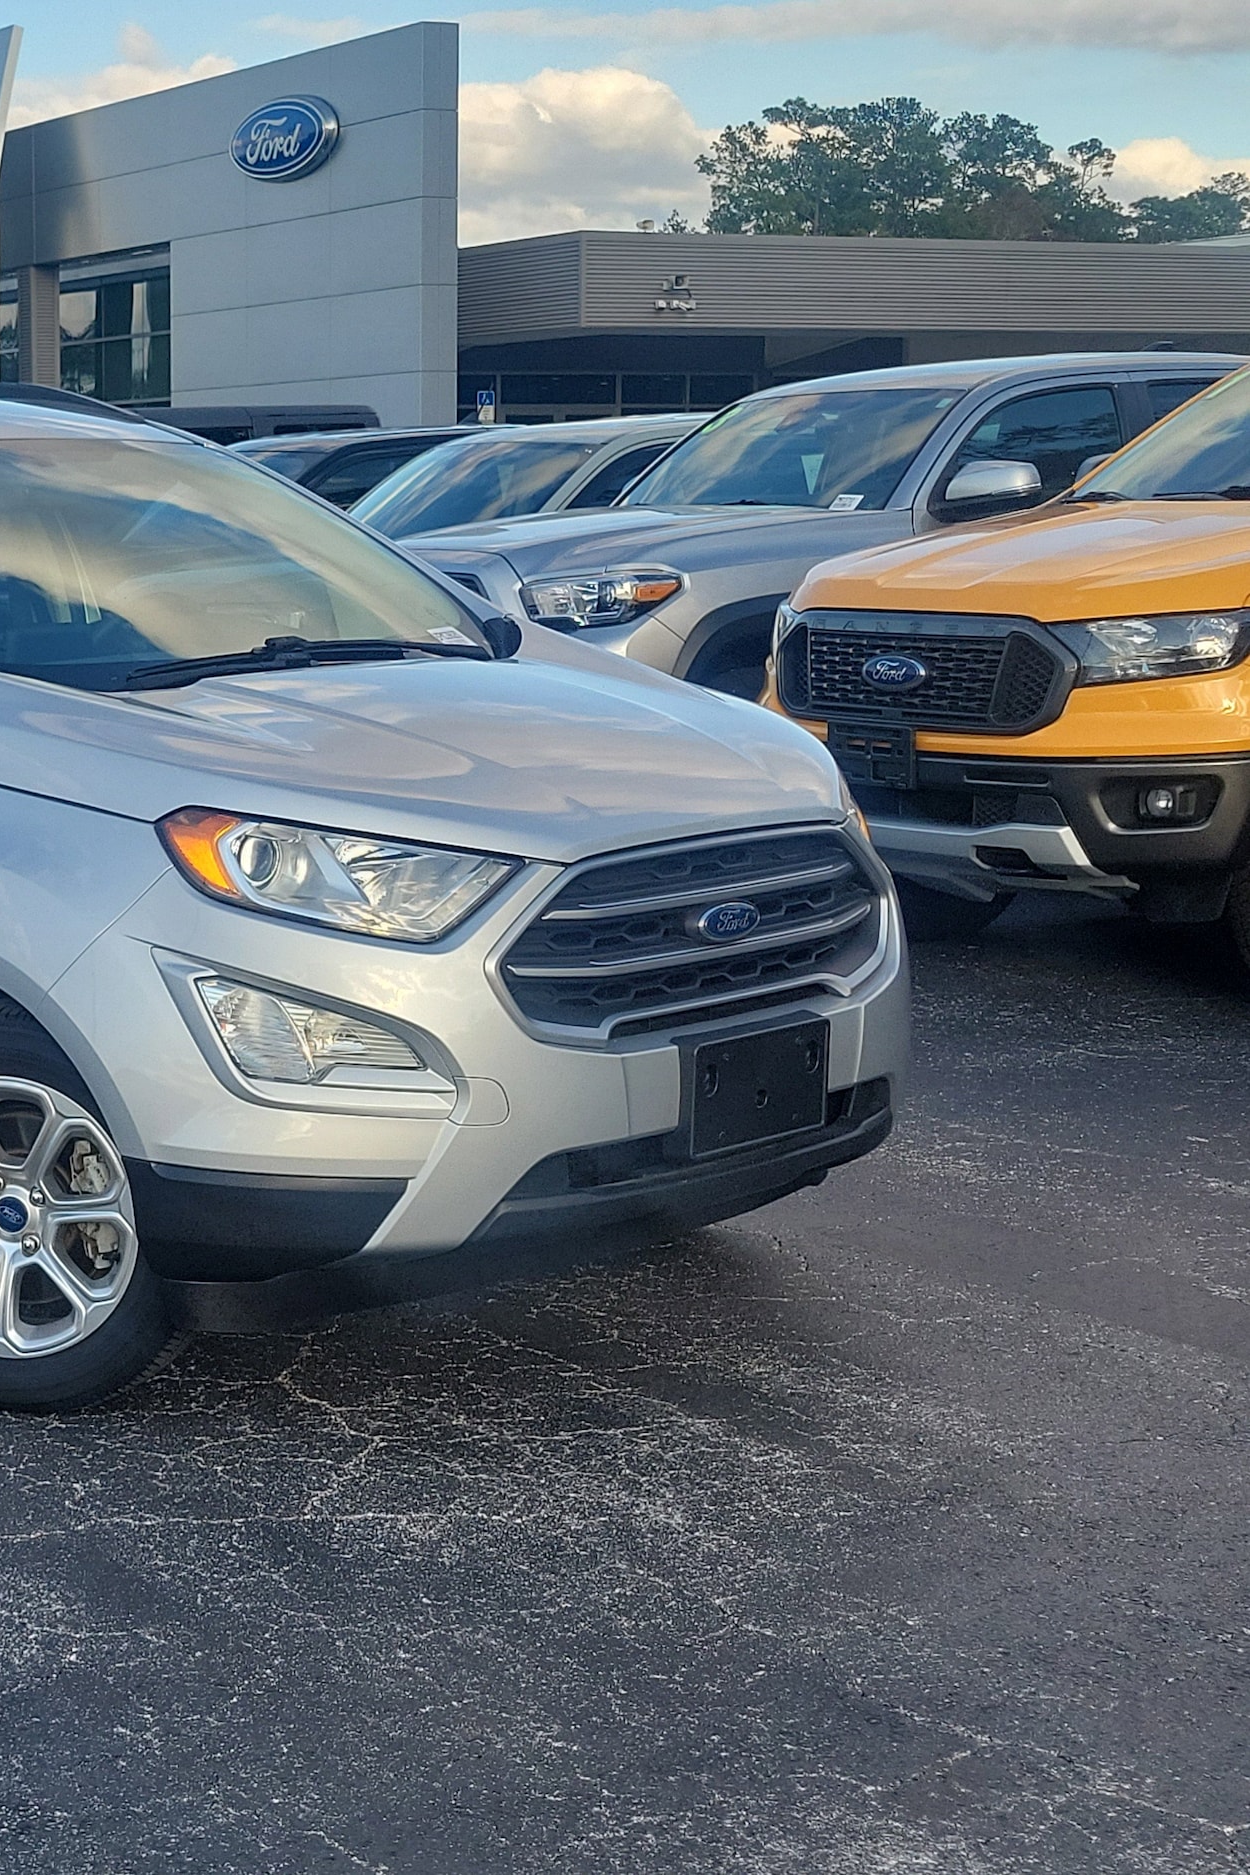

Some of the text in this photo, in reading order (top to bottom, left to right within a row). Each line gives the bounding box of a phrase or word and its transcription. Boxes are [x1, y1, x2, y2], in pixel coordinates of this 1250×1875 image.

[246, 116, 302, 165] Ford
[872, 660, 907, 681] Ford
[717, 909, 750, 932] Ford
